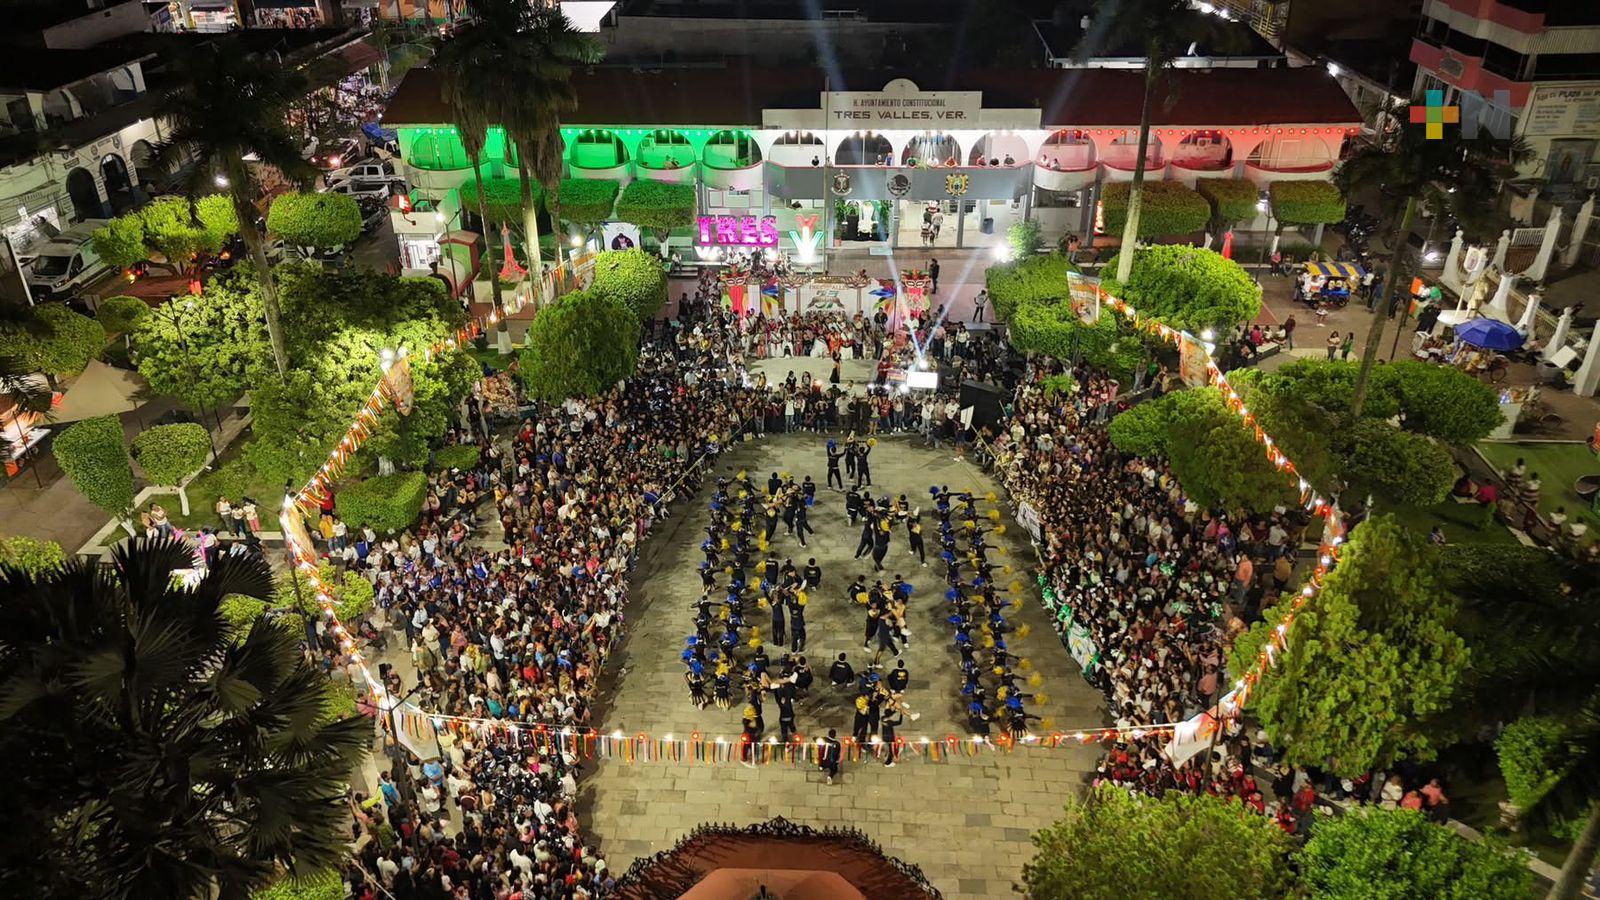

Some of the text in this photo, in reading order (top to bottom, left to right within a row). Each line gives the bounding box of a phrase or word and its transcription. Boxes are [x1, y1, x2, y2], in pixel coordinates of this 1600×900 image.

[861, 99, 901, 107] AYUNTAMIENTO
[903, 99, 945, 107] CONSTITUCIONAL
[834, 111, 966, 120] TRES VALLES, VER.
[696, 214, 778, 246] TRES
